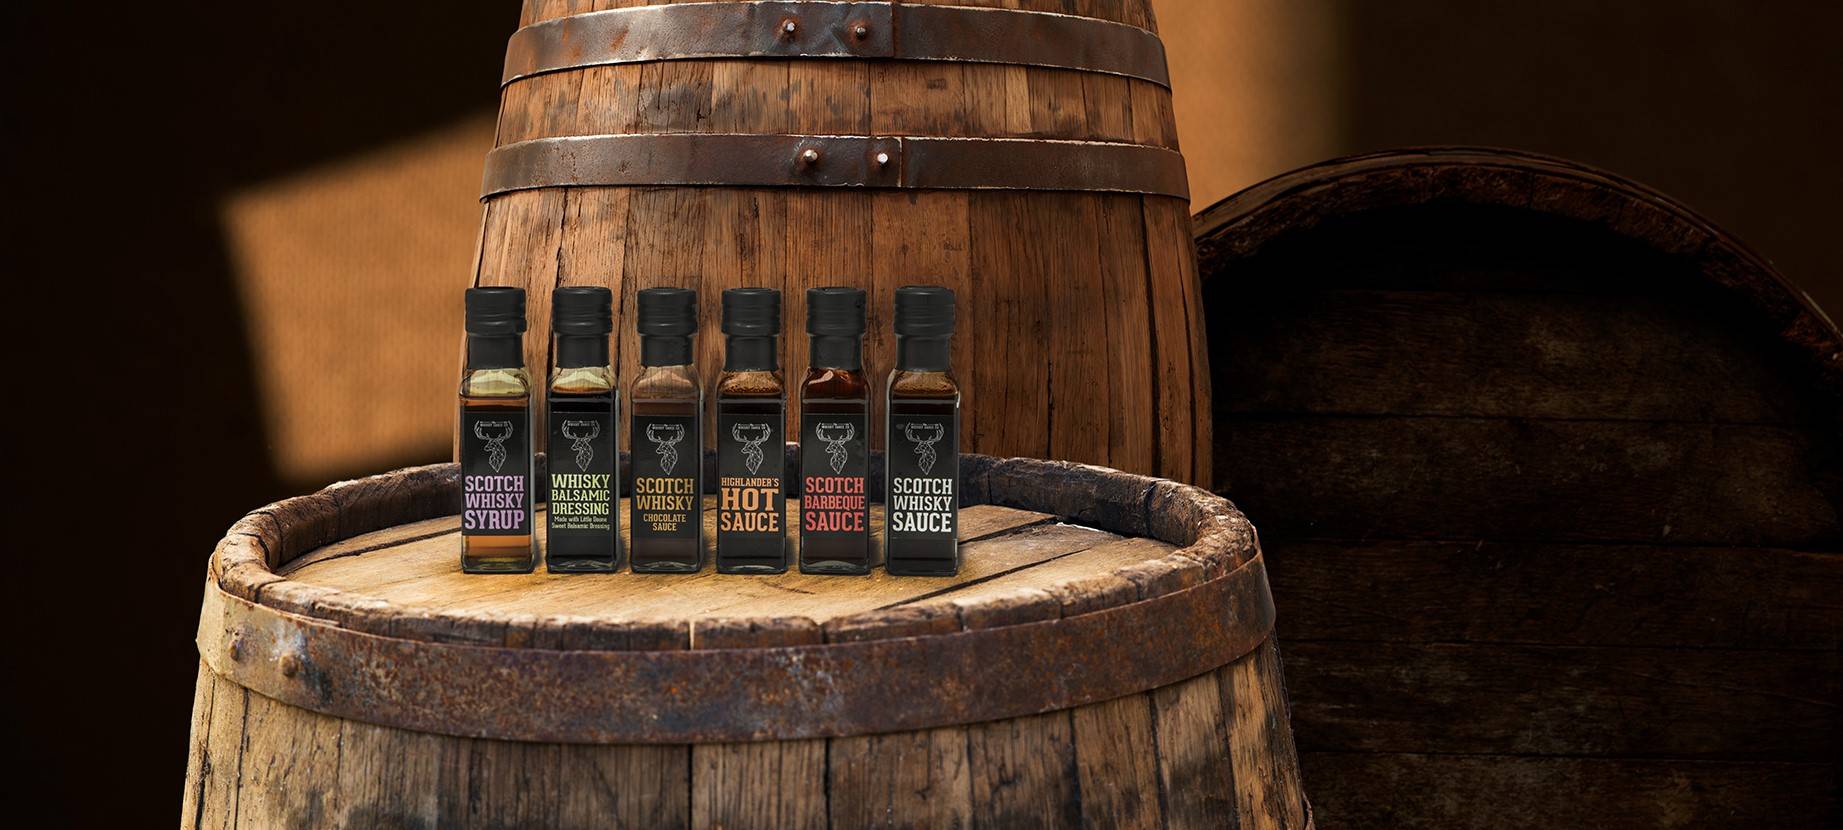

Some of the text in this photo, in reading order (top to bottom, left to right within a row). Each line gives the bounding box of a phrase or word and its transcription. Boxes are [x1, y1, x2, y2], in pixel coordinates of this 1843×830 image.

[465, 476, 524, 491] SCOTCH
[552, 474, 610, 488] WHISKY
[636, 478, 694, 494] SCOTCH
[721, 478, 779, 487] HIGHLANDER'S
[806, 477, 864, 493] SCOTCH
[894, 478, 952, 494] SCOTCH
[465, 493, 524, 508] WHISKY
[552, 490, 609, 501] BALSAMIC
[637, 496, 694, 510] WHISKY
[721, 489, 779, 511] HOT
[805, 496, 864, 510] BARBEQUE
[552, 503, 609, 515] DRESSING
[894, 496, 952, 511] WHISKY
[465, 510, 524, 529] SYRUP
[643, 514, 686, 522] CHOCOLATE
[721, 513, 779, 531] SAUCE
[806, 512, 864, 531] SAUCE
[893, 513, 951, 532] SAUCE
[653, 523, 677, 531] SAUCE
